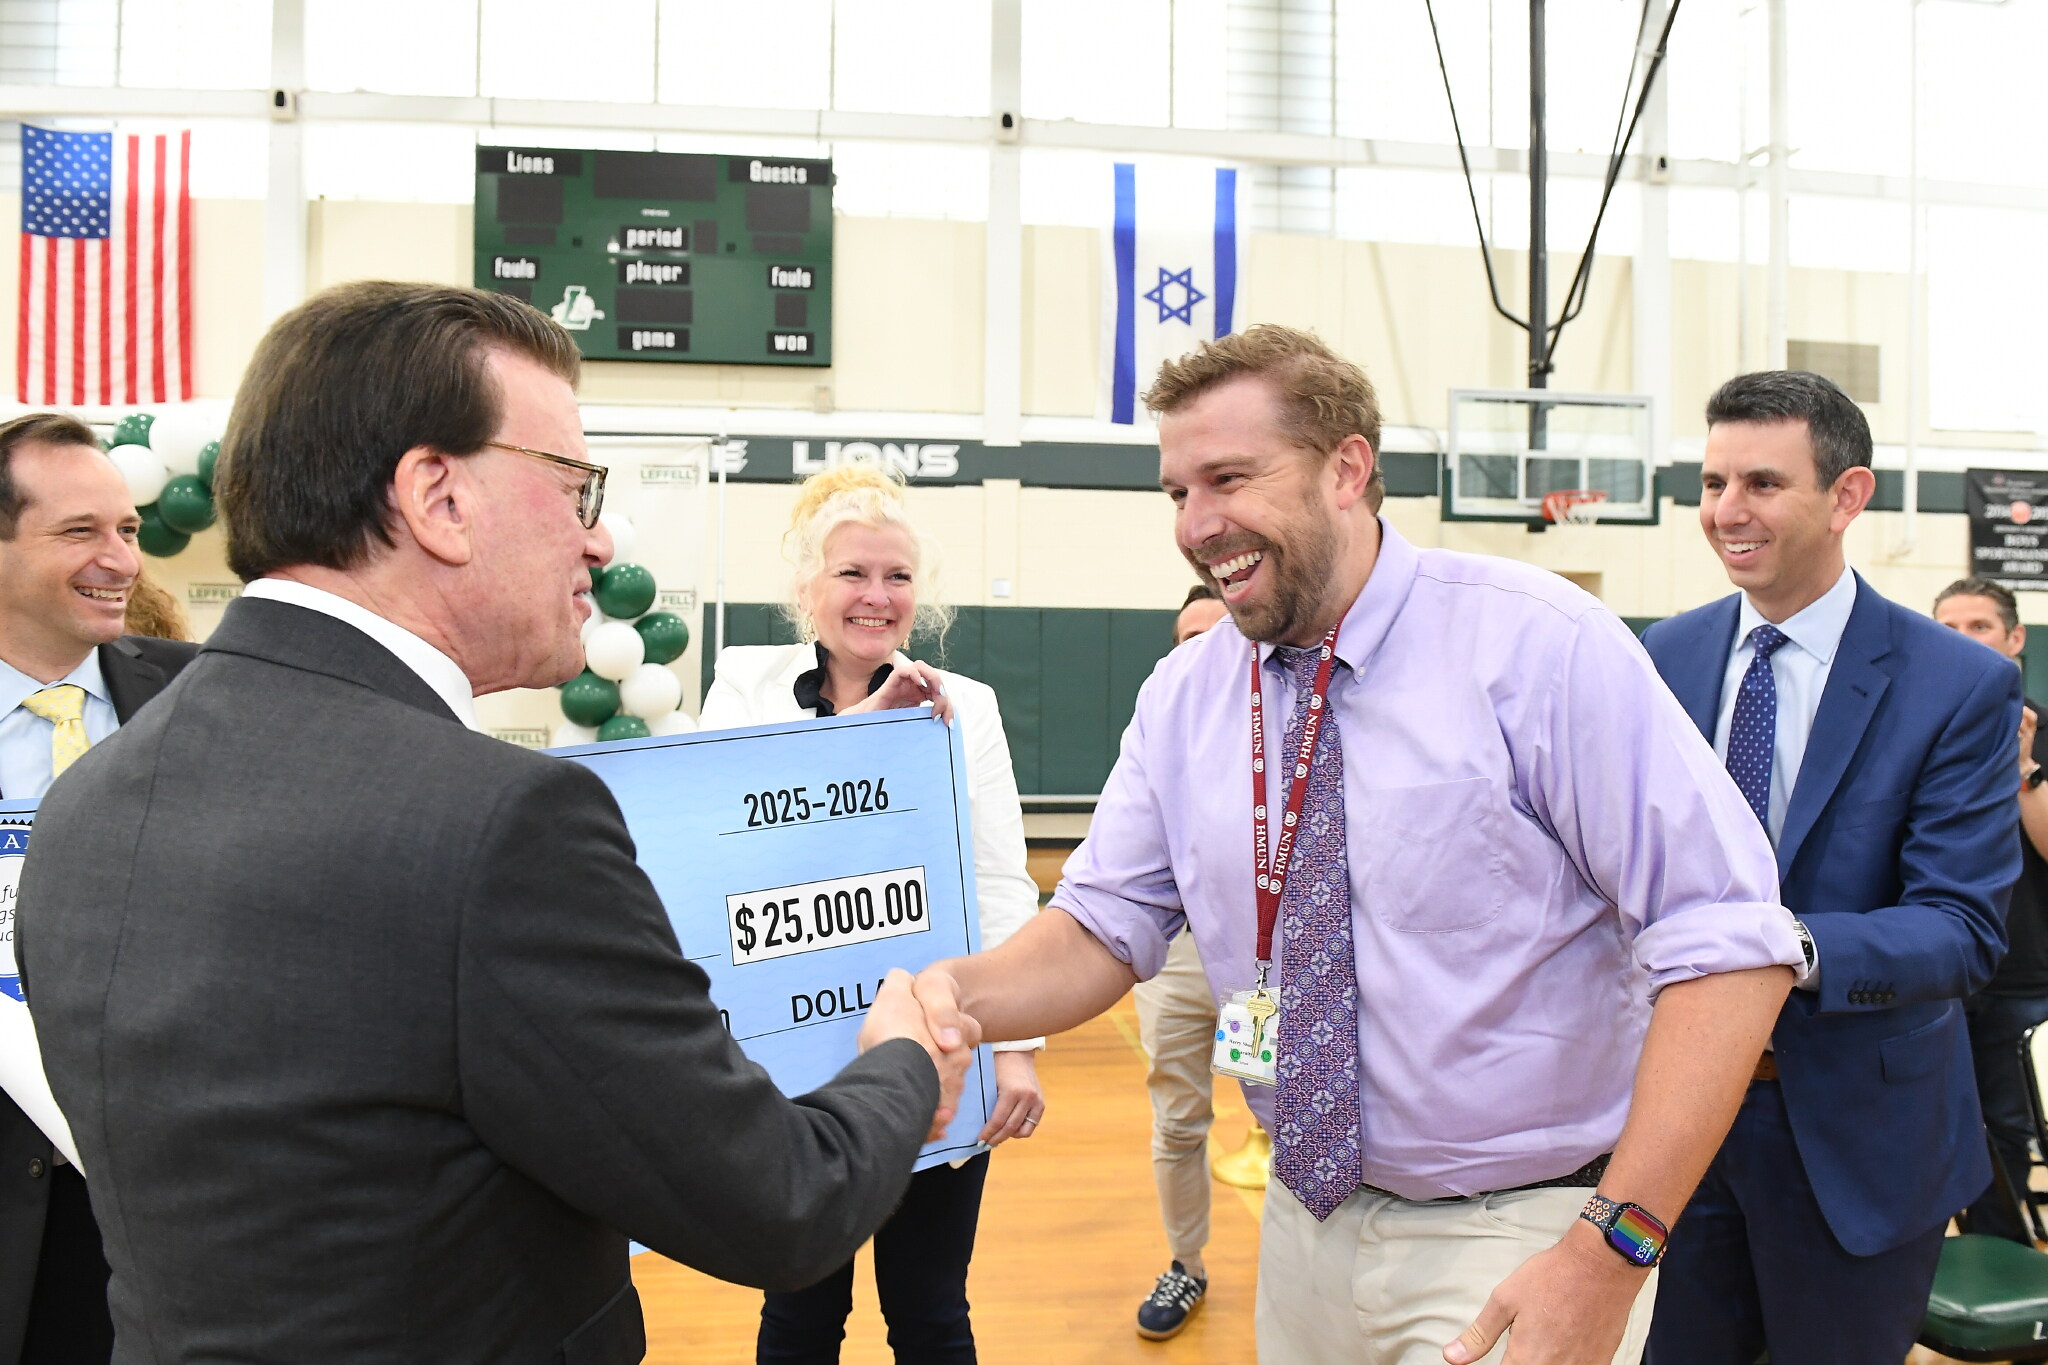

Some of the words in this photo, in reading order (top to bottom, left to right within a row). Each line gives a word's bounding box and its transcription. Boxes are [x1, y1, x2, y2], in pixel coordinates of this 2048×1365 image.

[507, 150, 554, 174] Lions
[750, 160, 808, 184] Guests
[626, 227, 683, 249] period
[495, 256, 536, 279] fouls
[626, 260, 683, 284] player
[772, 266, 811, 288] fouls
[632, 331, 675, 350] game
[774, 334, 808, 353] won
[792, 441, 960, 477] LIONS
[1253, 711, 1263, 754] HMUN
[1300, 714, 1318, 759] HMUN
[743, 777, 889, 827] 2025-2026
[1256, 824, 1267, 869] HMUN
[1274, 831, 1292, 875] HMUN
[735, 879, 924, 955] $25,000.00
[1635, 1237, 1652, 1259] 10:53
